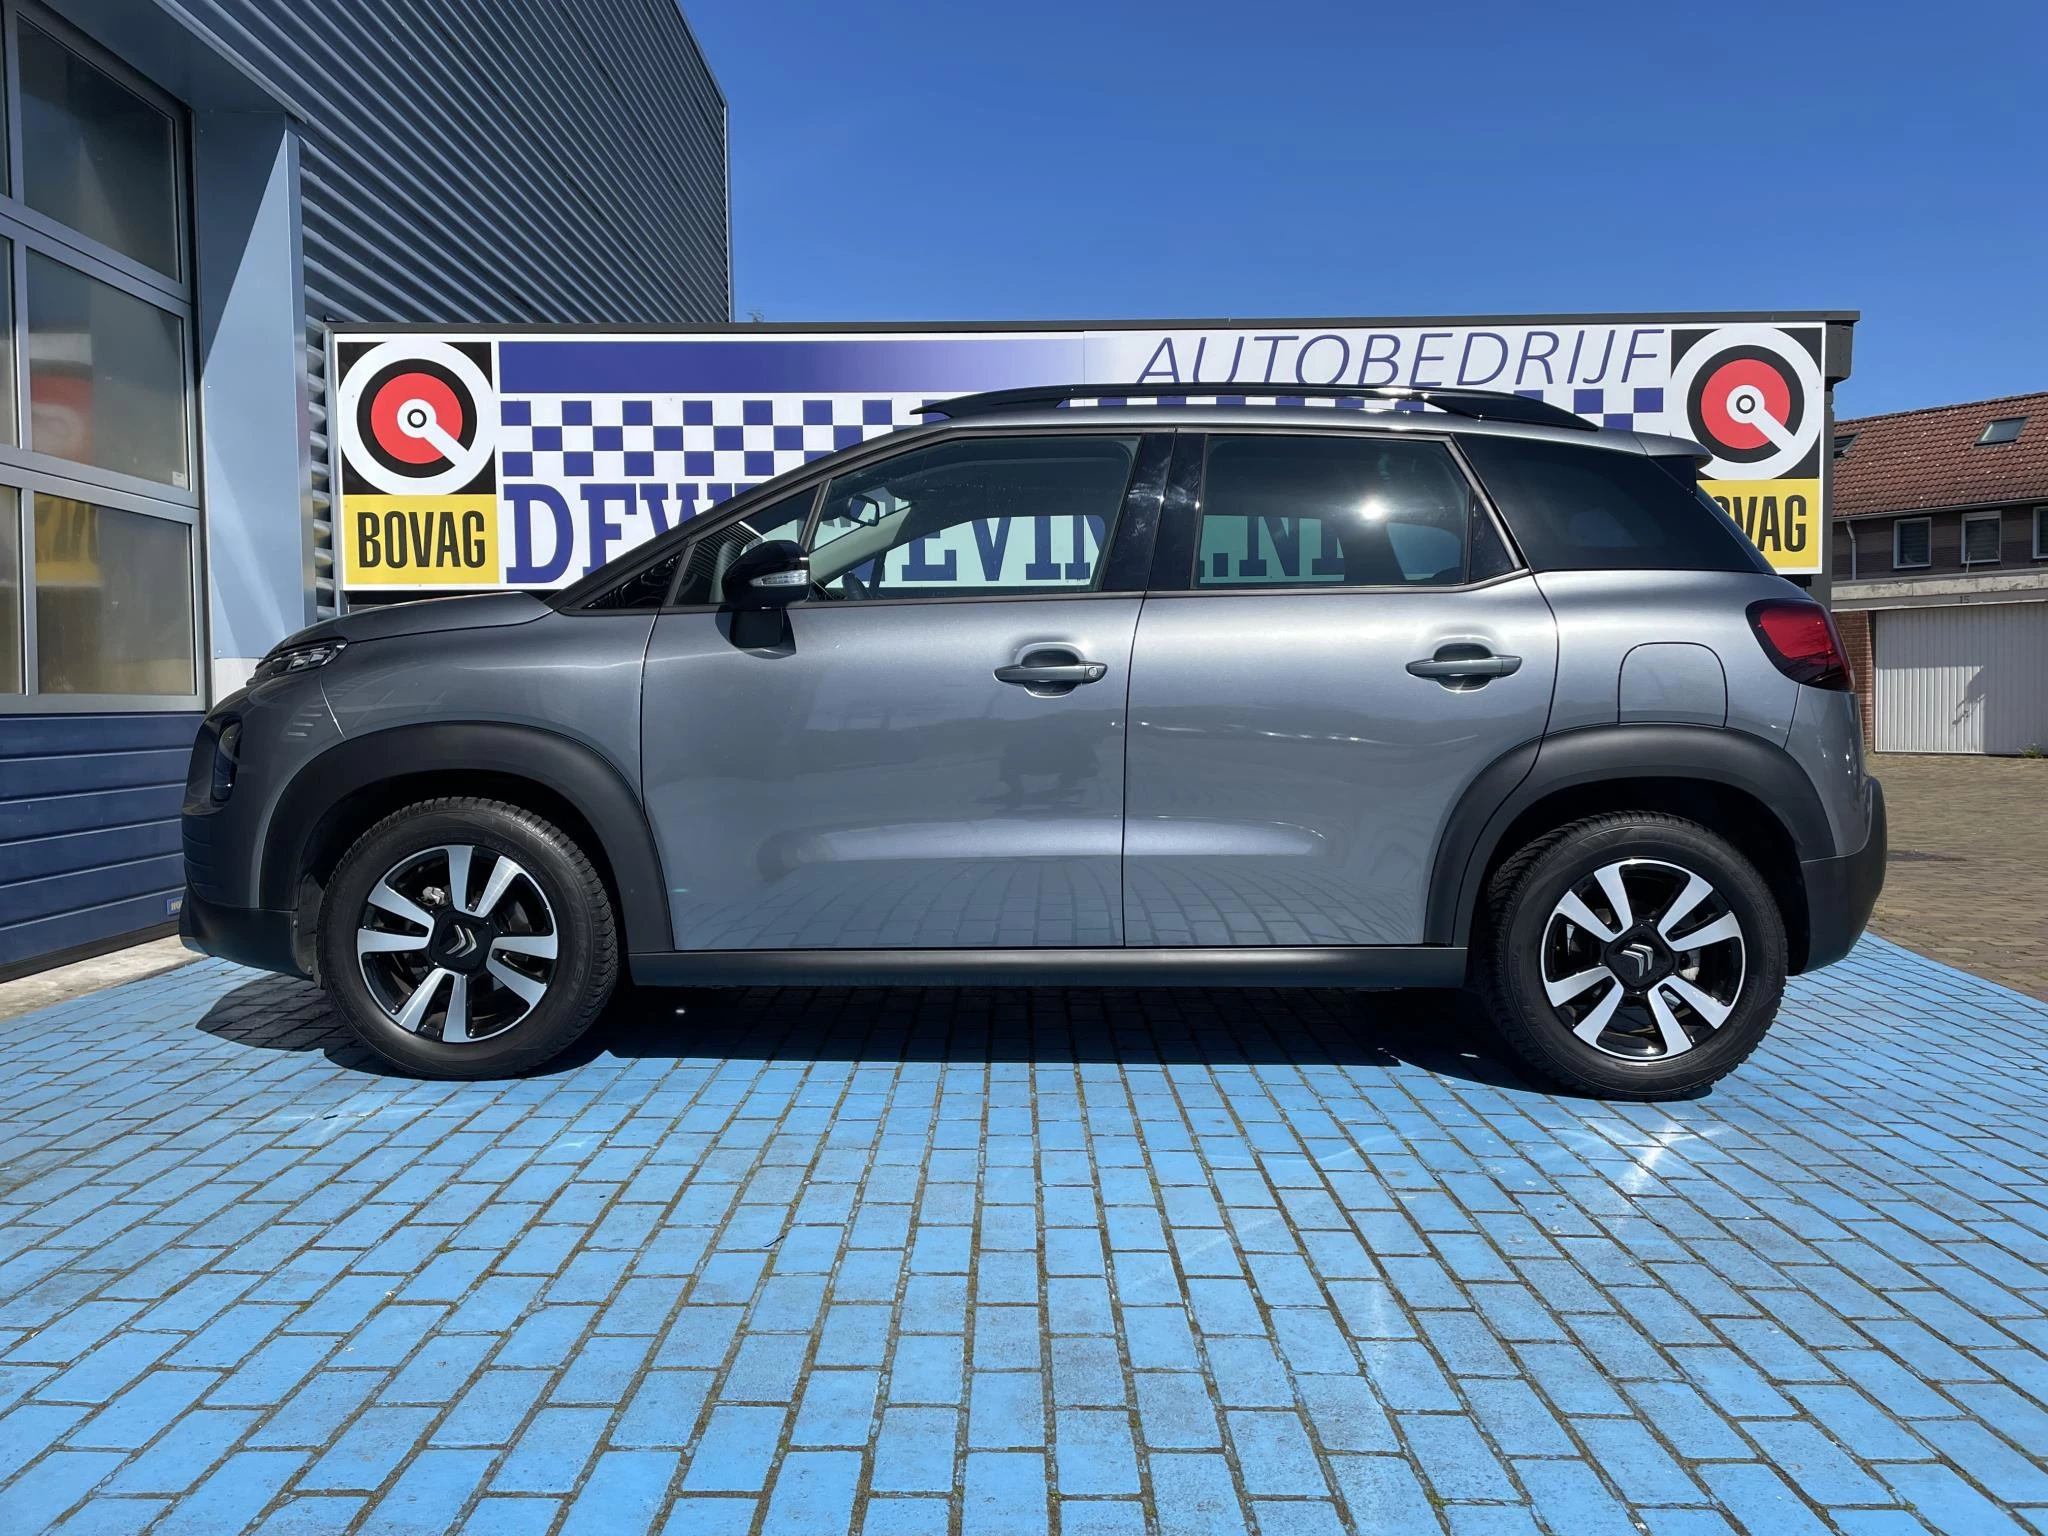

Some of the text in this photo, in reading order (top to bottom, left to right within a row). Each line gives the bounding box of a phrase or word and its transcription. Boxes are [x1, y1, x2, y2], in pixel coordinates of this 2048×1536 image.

[1135, 328, 1665, 386] AUTOBEDRIJF
[357, 510, 486, 569] BOVAG
[1713, 494, 1807, 552] VAG
